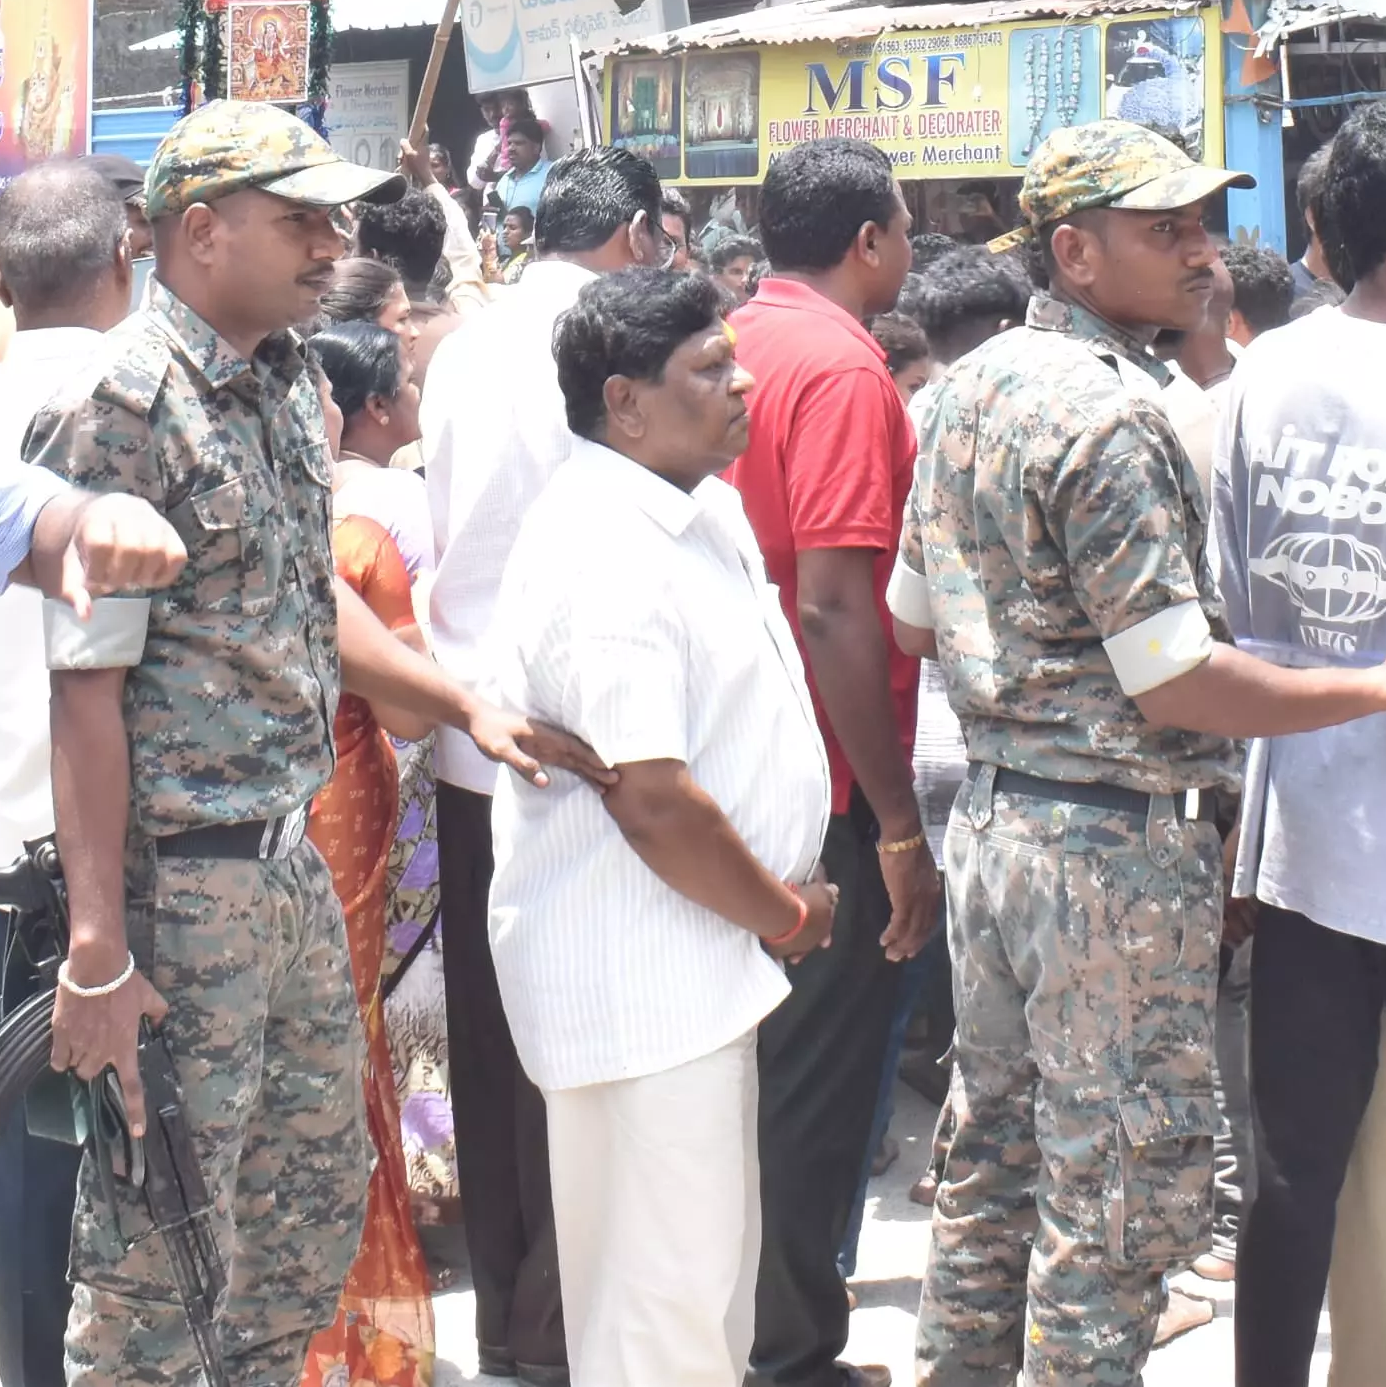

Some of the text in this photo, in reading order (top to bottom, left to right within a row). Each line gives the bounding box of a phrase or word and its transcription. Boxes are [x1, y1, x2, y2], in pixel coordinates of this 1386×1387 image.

[802, 52, 967, 115] MSF
[768, 111, 1003, 143] FLOWER MERCHANT & DECORATER
[923, 143, 1003, 166] Merchant
